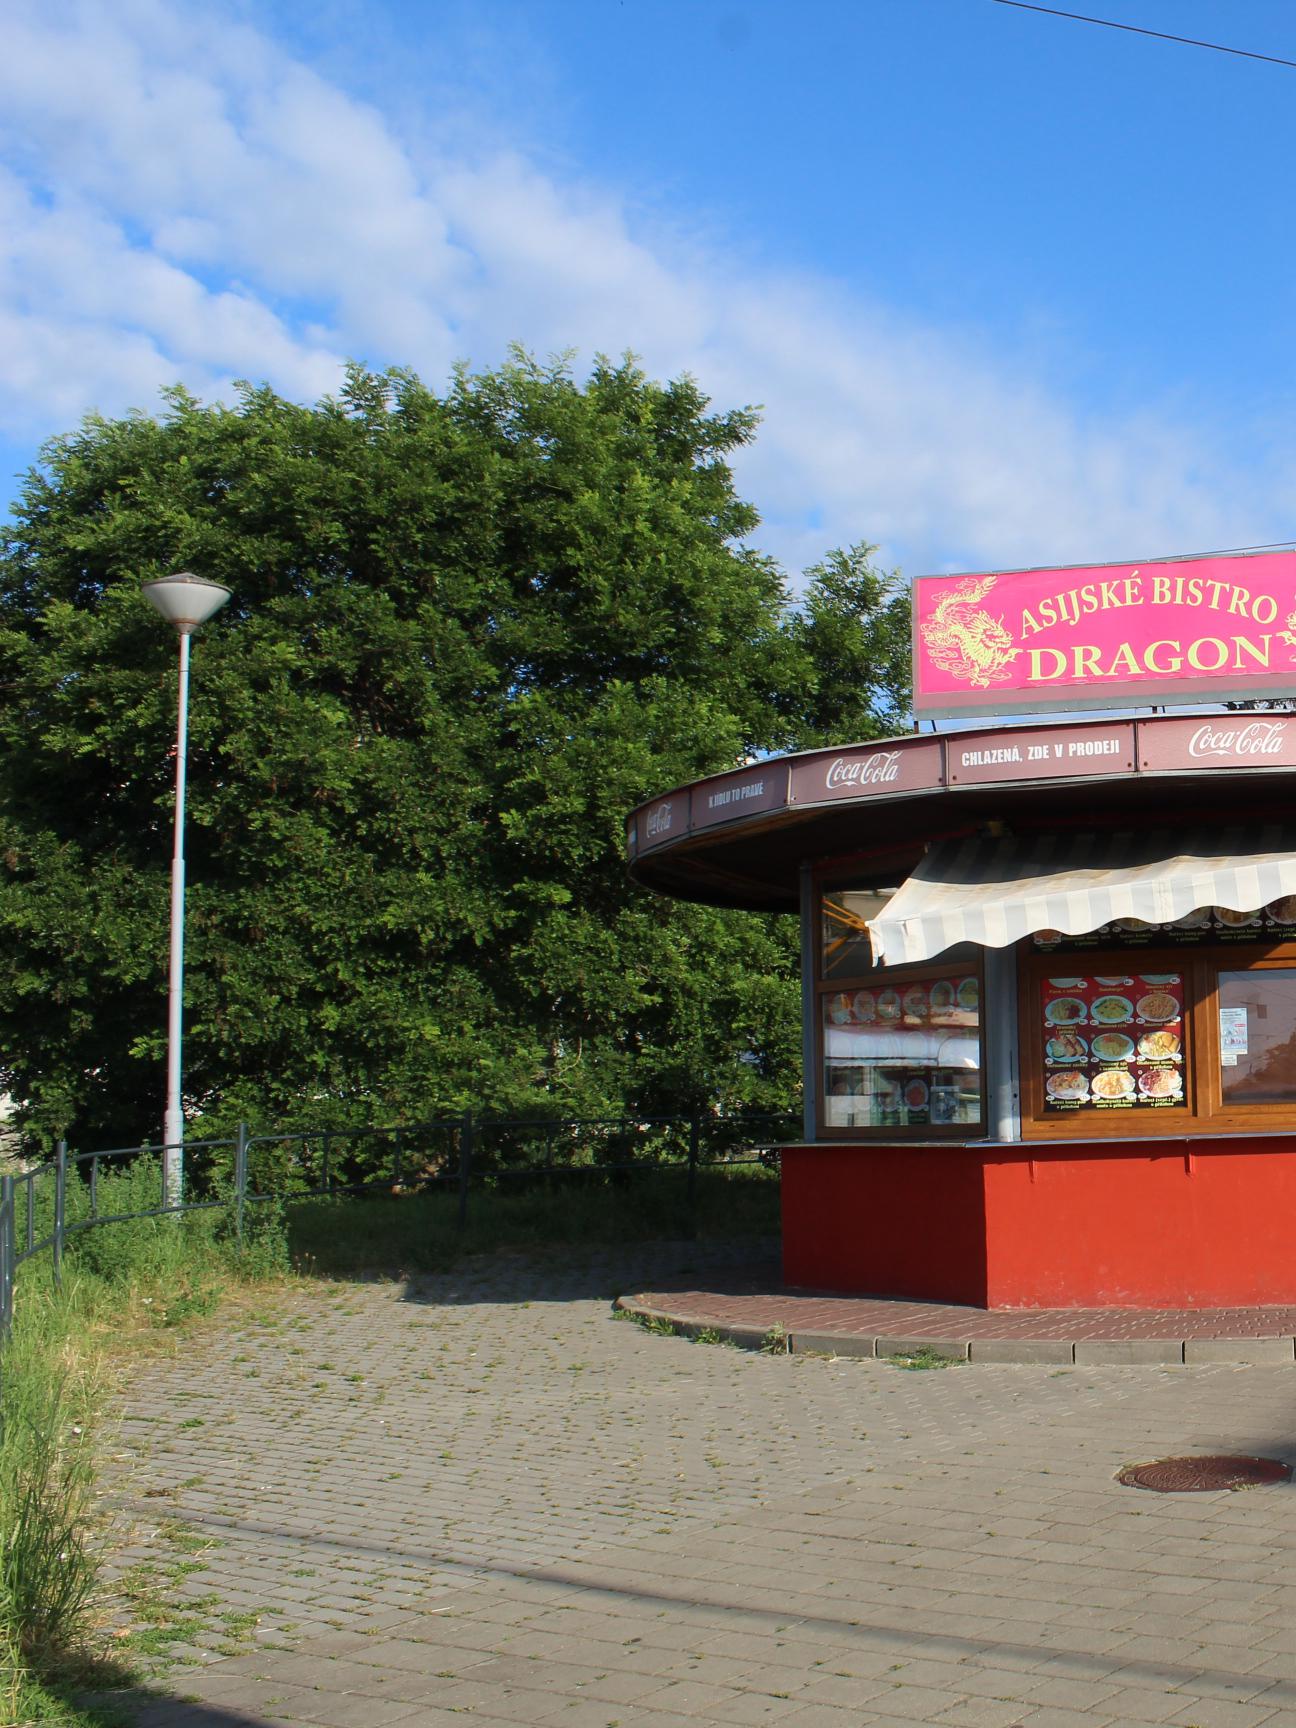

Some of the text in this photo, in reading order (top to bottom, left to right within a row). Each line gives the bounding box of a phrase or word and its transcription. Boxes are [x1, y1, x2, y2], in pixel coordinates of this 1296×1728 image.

[1019, 570, 1278, 640] ASIJSKÉ BISTRO
[1026, 634, 1272, 682] DRAGON
[961, 739, 1120, 767] CHLAZENÁ, ZDE V PRODEJI
